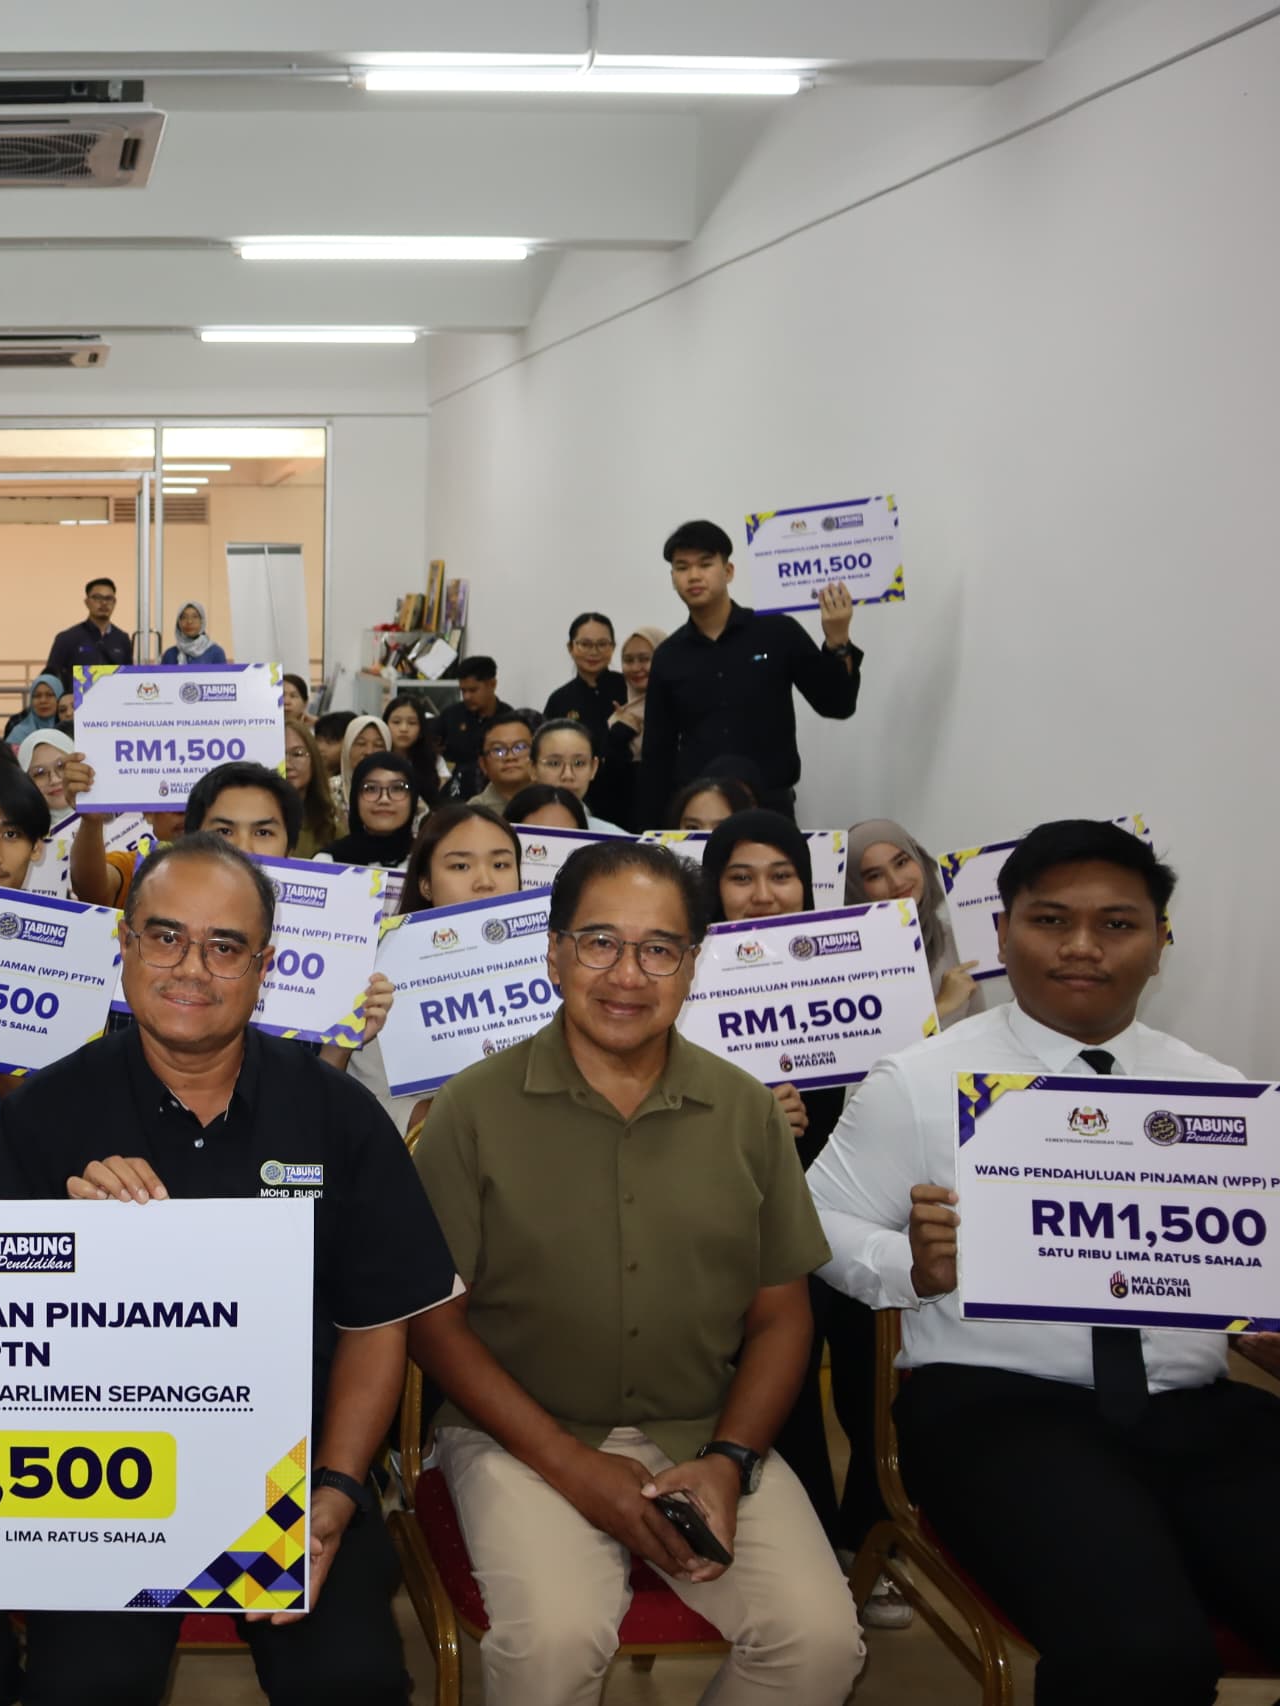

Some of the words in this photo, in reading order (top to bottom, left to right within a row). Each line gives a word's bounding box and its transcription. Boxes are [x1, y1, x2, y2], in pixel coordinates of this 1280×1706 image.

[778, 552, 872, 578] RM1,500
[202, 685, 235, 693] TABUNG
[83, 720, 109, 728] WANG
[111, 720, 175, 728] PENDAHULUAN
[176, 719, 220, 727] PINJAMAN
[222, 719, 247, 727] (WPP)
[115, 738, 245, 765] RM1,500
[286, 884, 326, 899] TABUNG
[958, 898, 982, 908] WANG
[22, 919, 66, 938] TABUNG
[507, 913, 547, 929] TABUNG
[302, 928, 332, 941] (WPP)
[335, 934, 368, 944] PTPTN
[817, 932, 859, 947] TABUNG
[37, 966, 69, 981] (WPP)
[71, 973, 105, 987] PTPTN
[393, 982, 407, 992] NG
[410, 967, 485, 988] PENDAHULUAN
[487, 956, 537, 974] PINJAMAN
[278, 983, 316, 995] SAHAJA
[685, 991, 707, 1001] ANG
[709, 981, 788, 999] PENDAHULUAN
[791, 974, 845, 989] PINJAMAN
[848, 971, 879, 984] (WPP)
[881, 965, 915, 977] PTPTN
[420, 978, 563, 1028] RM1,50
[718, 994, 882, 1039] RM1,500
[9, 1020, 48, 1035] SAHAJA
[431, 1031, 455, 1042] SATU
[458, 1026, 480, 1036] RIBU
[482, 1021, 506, 1033] LIMA
[507, 1015, 538, 1027] RATUS
[727, 1044, 753, 1053] SATU
[755, 1040, 778, 1049] RIBU
[781, 1036, 806, 1047] LIMA
[807, 1032, 840, 1044] RATUS
[842, 1028, 881, 1040] SAHAJA
[795, 1057, 836, 1068] MADANI
[1184, 1117, 1245, 1133] TABUNG
[1185, 1131, 1245, 1145] Pendidikan
[286, 1167, 320, 1176] TABUNG
[975, 1165, 1020, 1177] WANG
[1024, 1167, 1136, 1182] PENDAHULUAN
[1140, 1172, 1218, 1186] PINJAMAN
[1222, 1175, 1267, 1190] (WPP)
[260, 1189, 289, 1197] MOHD
[294, 1190, 323, 1198] RUSDI
[1032, 1199, 1267, 1248] RM1,500
[1038, 1247, 1074, 1258] SATU
[1078, 1248, 1112, 1260] RIBU
[1116, 1251, 1150, 1262] LIMA
[1154, 1253, 1201, 1265] RATUS
[1205, 1255, 1262, 1268] SAHAJA
[1131, 1276, 1190, 1288] MALAYSIA
[1131, 1285, 1191, 1298] MADANI
[46, 1302, 238, 1328] PINJAMAN
[108, 1385, 250, 1403] SEPANGGAR
[6, 1531, 43, 1542] LIMA
[48, 1531, 99, 1543] RATUS
[103, 1531, 166, 1544] SAHAJA
